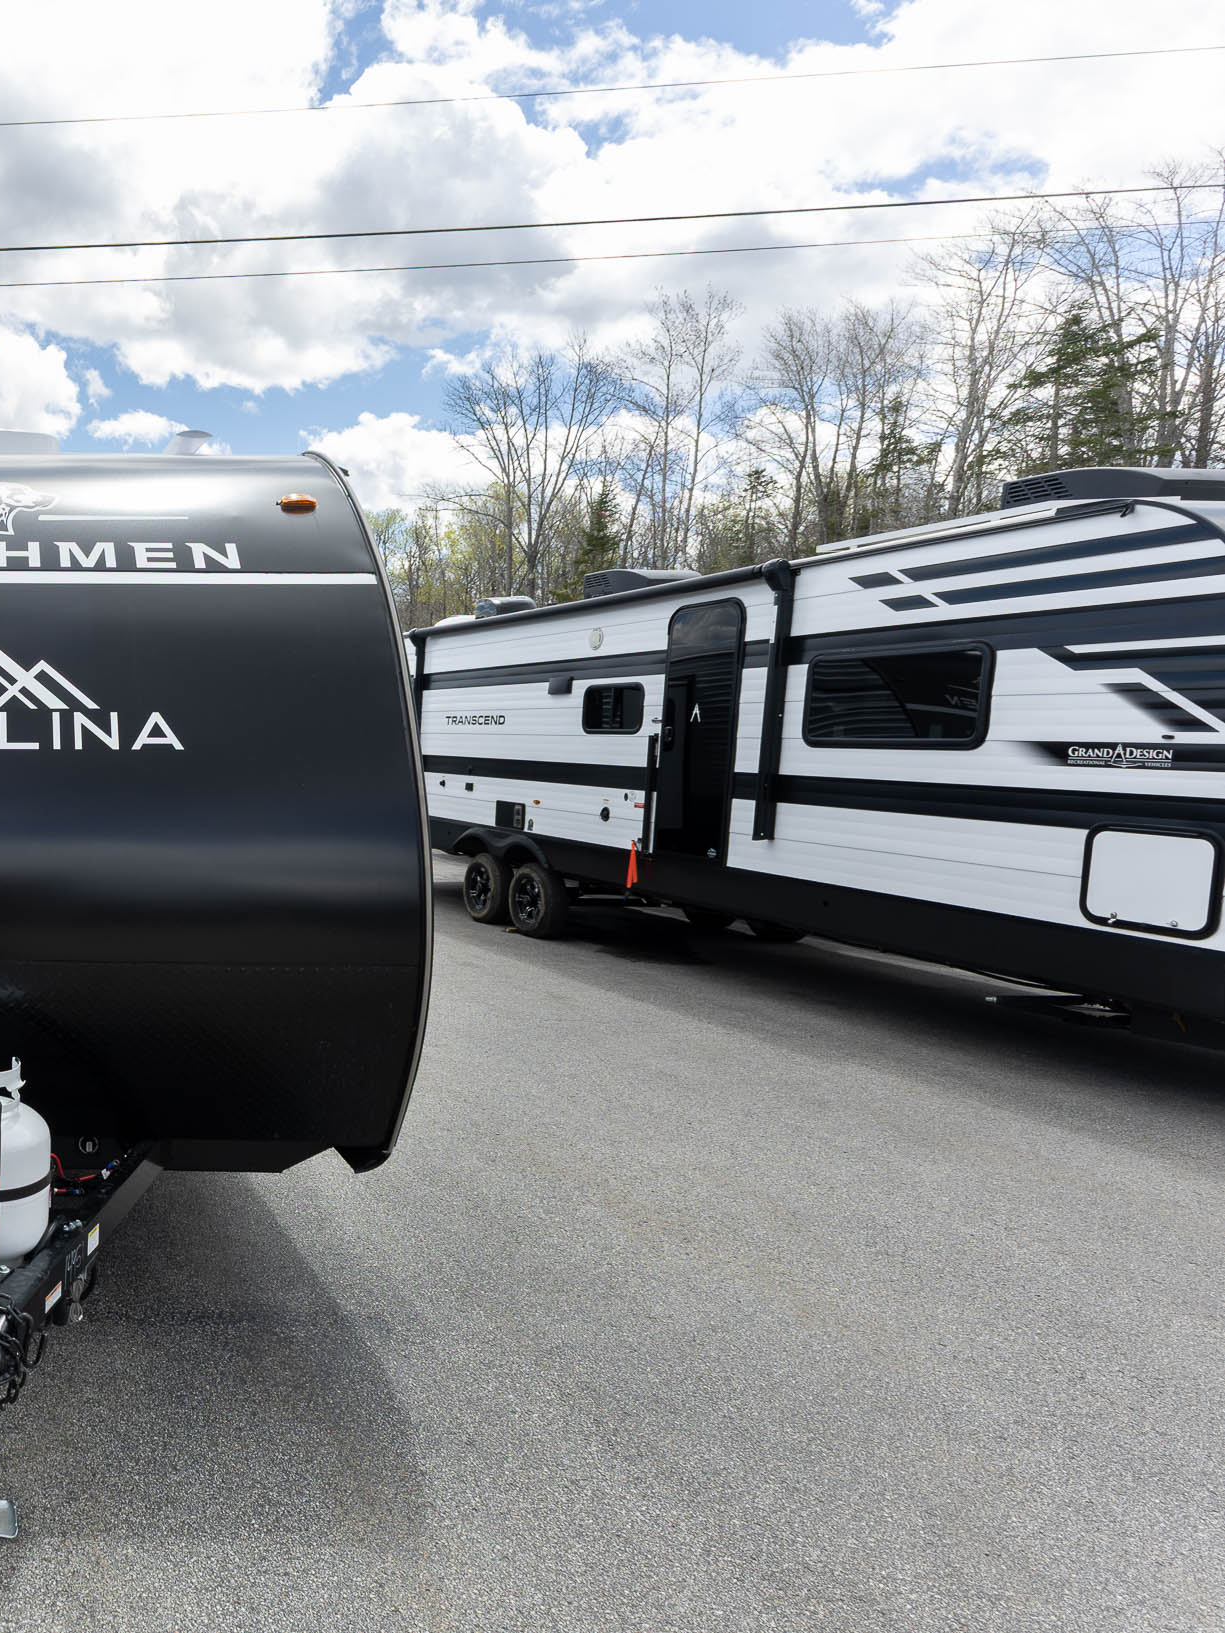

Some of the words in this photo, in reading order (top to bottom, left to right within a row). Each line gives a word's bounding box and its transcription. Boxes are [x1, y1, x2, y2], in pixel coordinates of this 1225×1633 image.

[445, 714, 506, 725] TRANSCEND
[1068, 746, 1113, 758] GRAND
[1125, 747, 1173, 759] DESIGN
